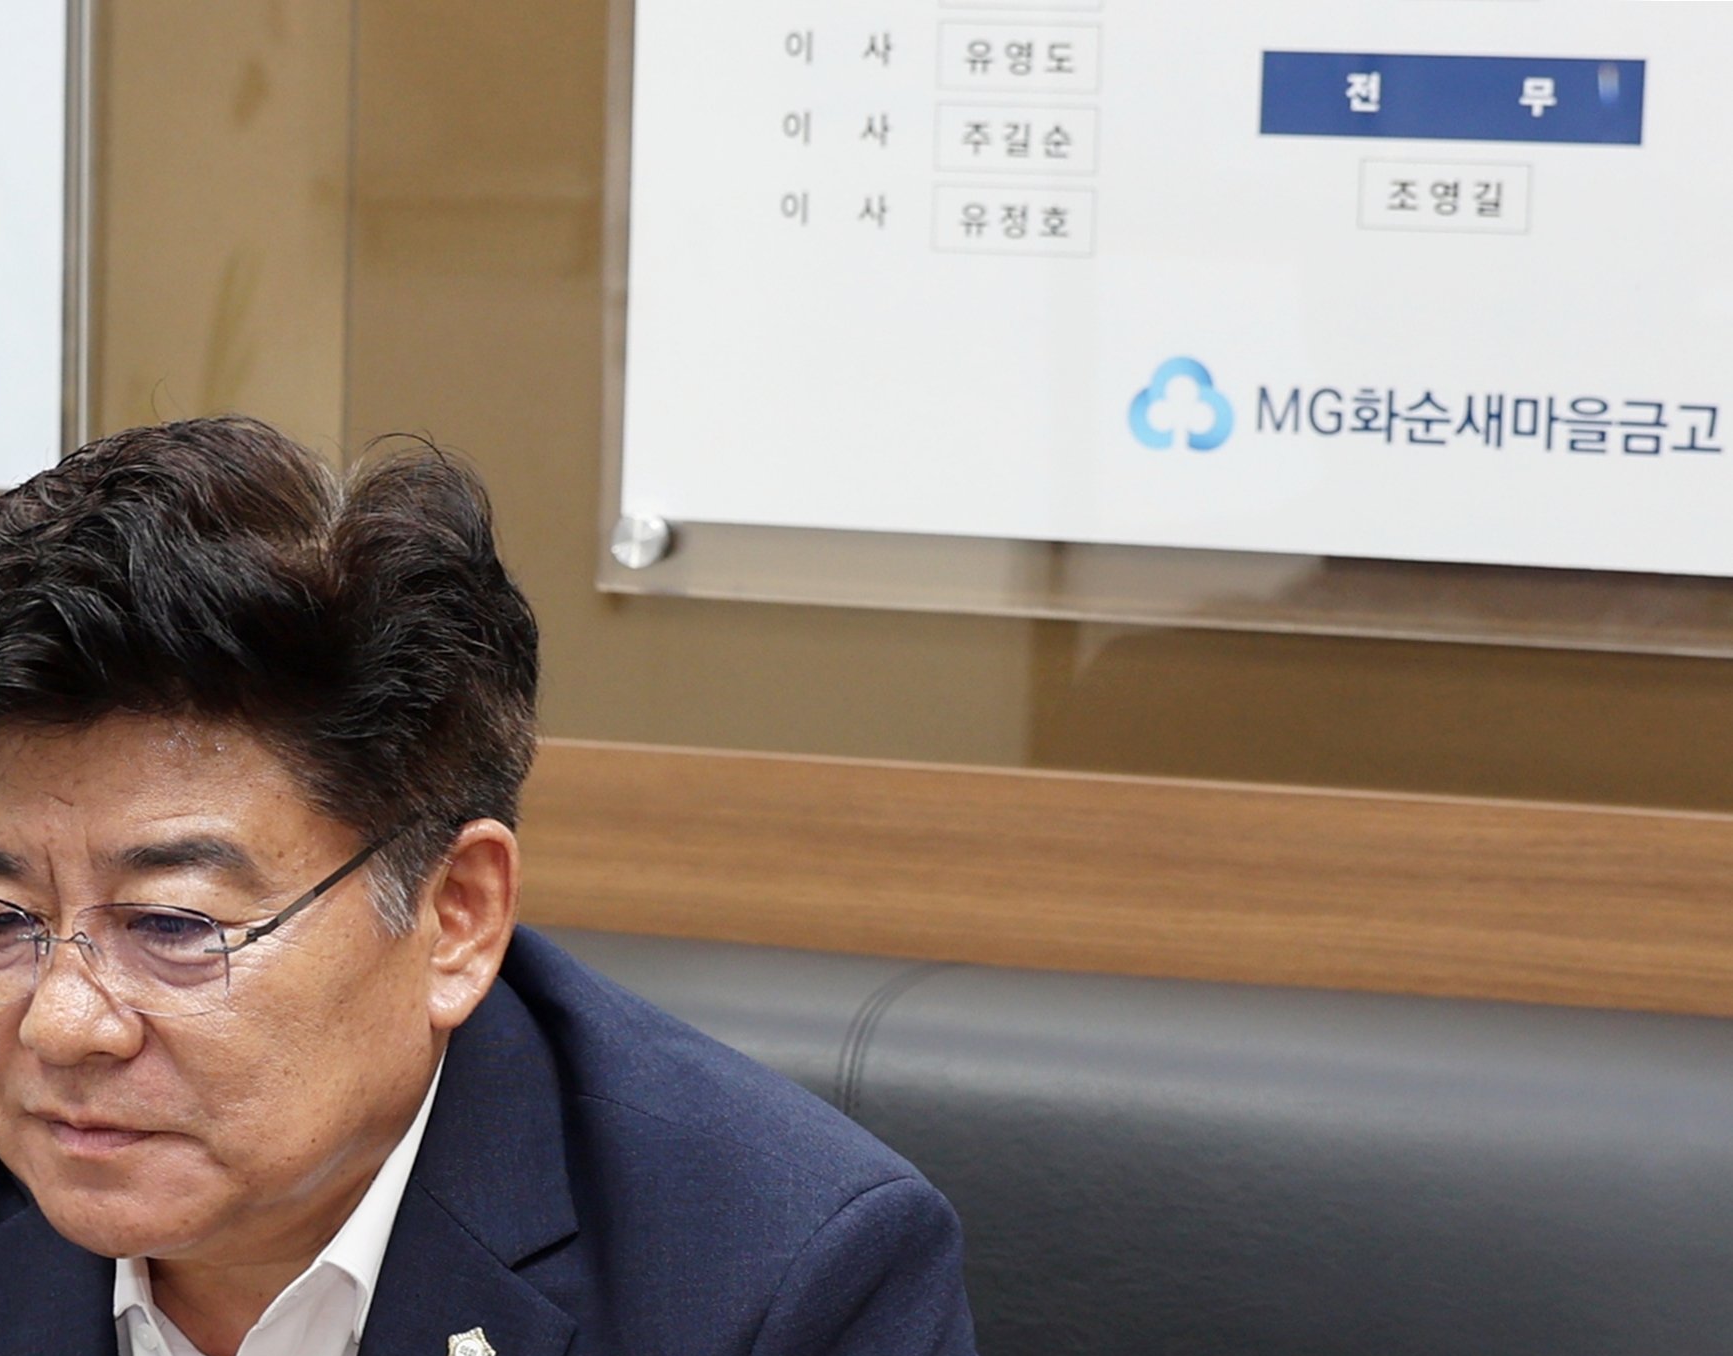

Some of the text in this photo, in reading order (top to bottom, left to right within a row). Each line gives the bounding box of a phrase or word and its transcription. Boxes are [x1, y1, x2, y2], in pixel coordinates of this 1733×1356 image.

[967, 41, 1074, 77] 유영도
[965, 123, 1072, 159] 주길순
[1390, 182, 1503, 218] 조영길
[962, 203, 1069, 239] 유정호
[1255, 387, 1723, 457] MG화순새마을금고
